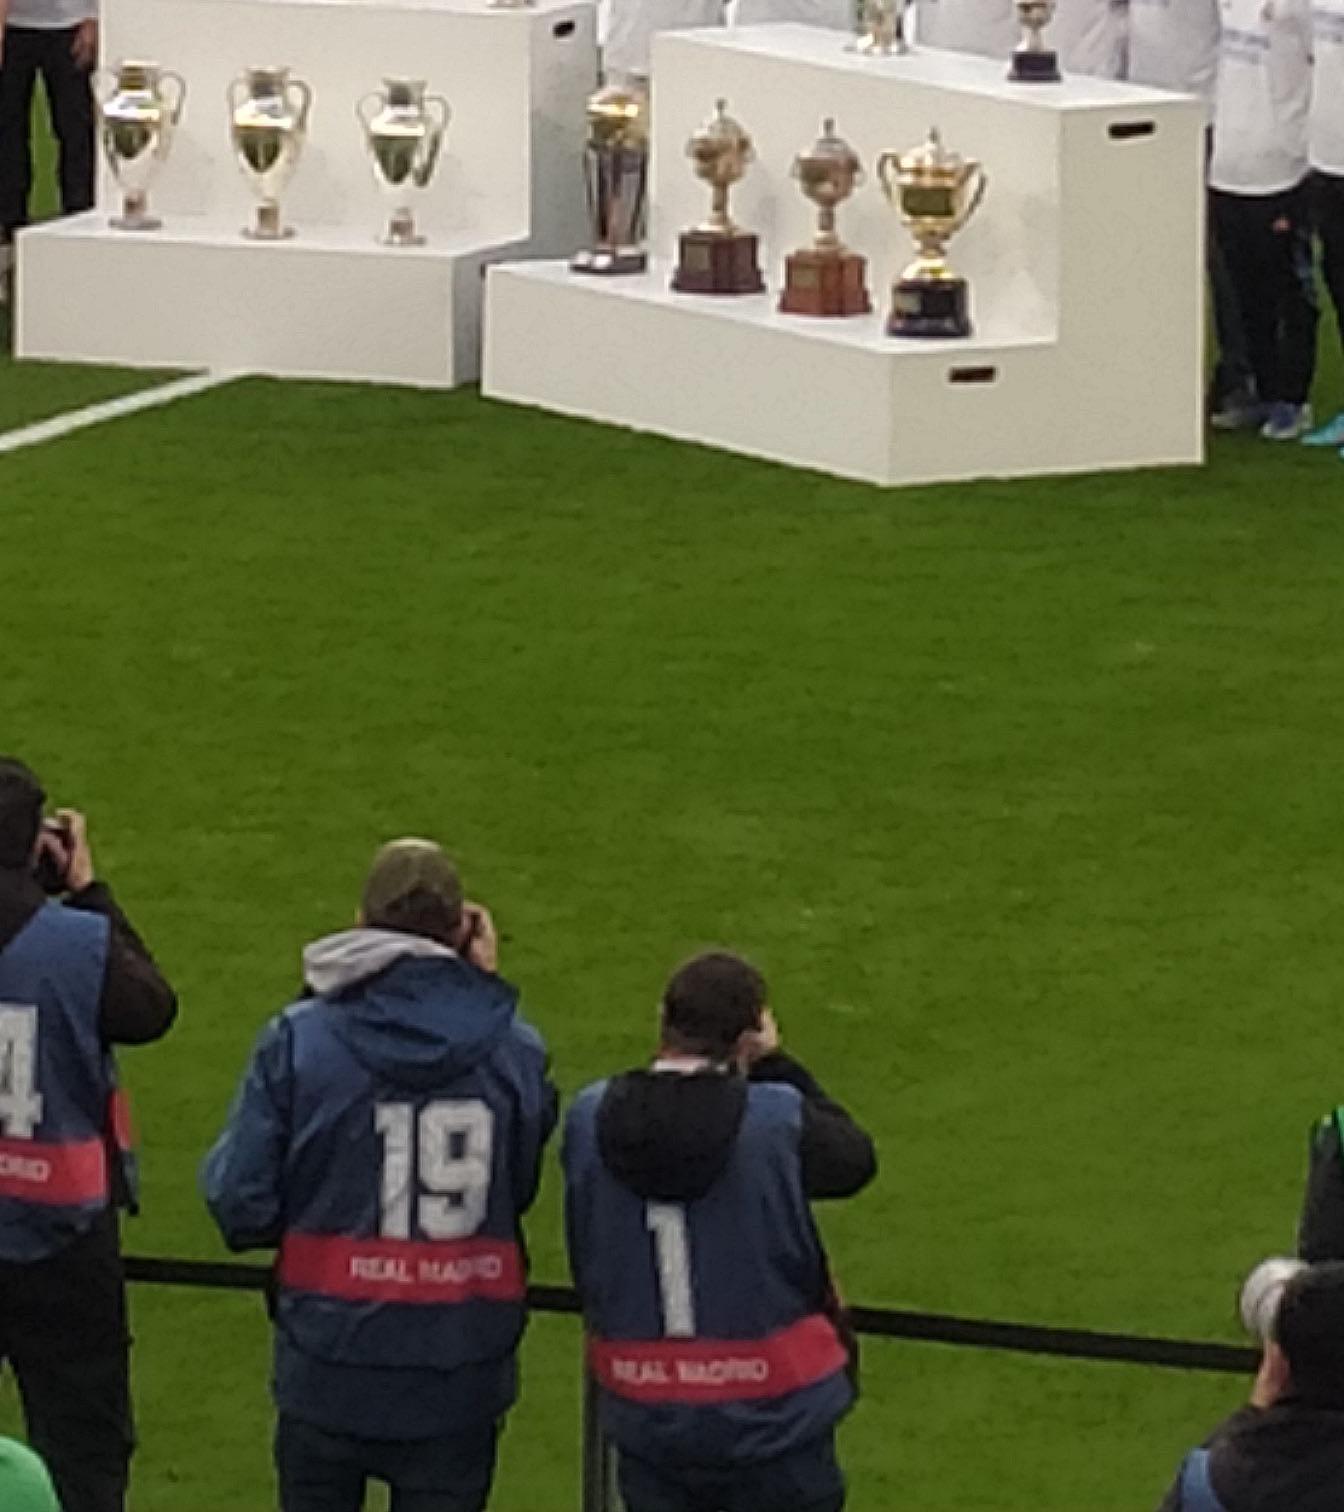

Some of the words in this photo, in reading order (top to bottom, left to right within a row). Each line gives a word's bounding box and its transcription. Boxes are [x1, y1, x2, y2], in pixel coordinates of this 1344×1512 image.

[374, 1100, 494, 1240] 19
[350, 1255, 414, 1284] REAL
[418, 1254, 502, 1284] MADRID
[646, 1200, 696, 1338] 1
